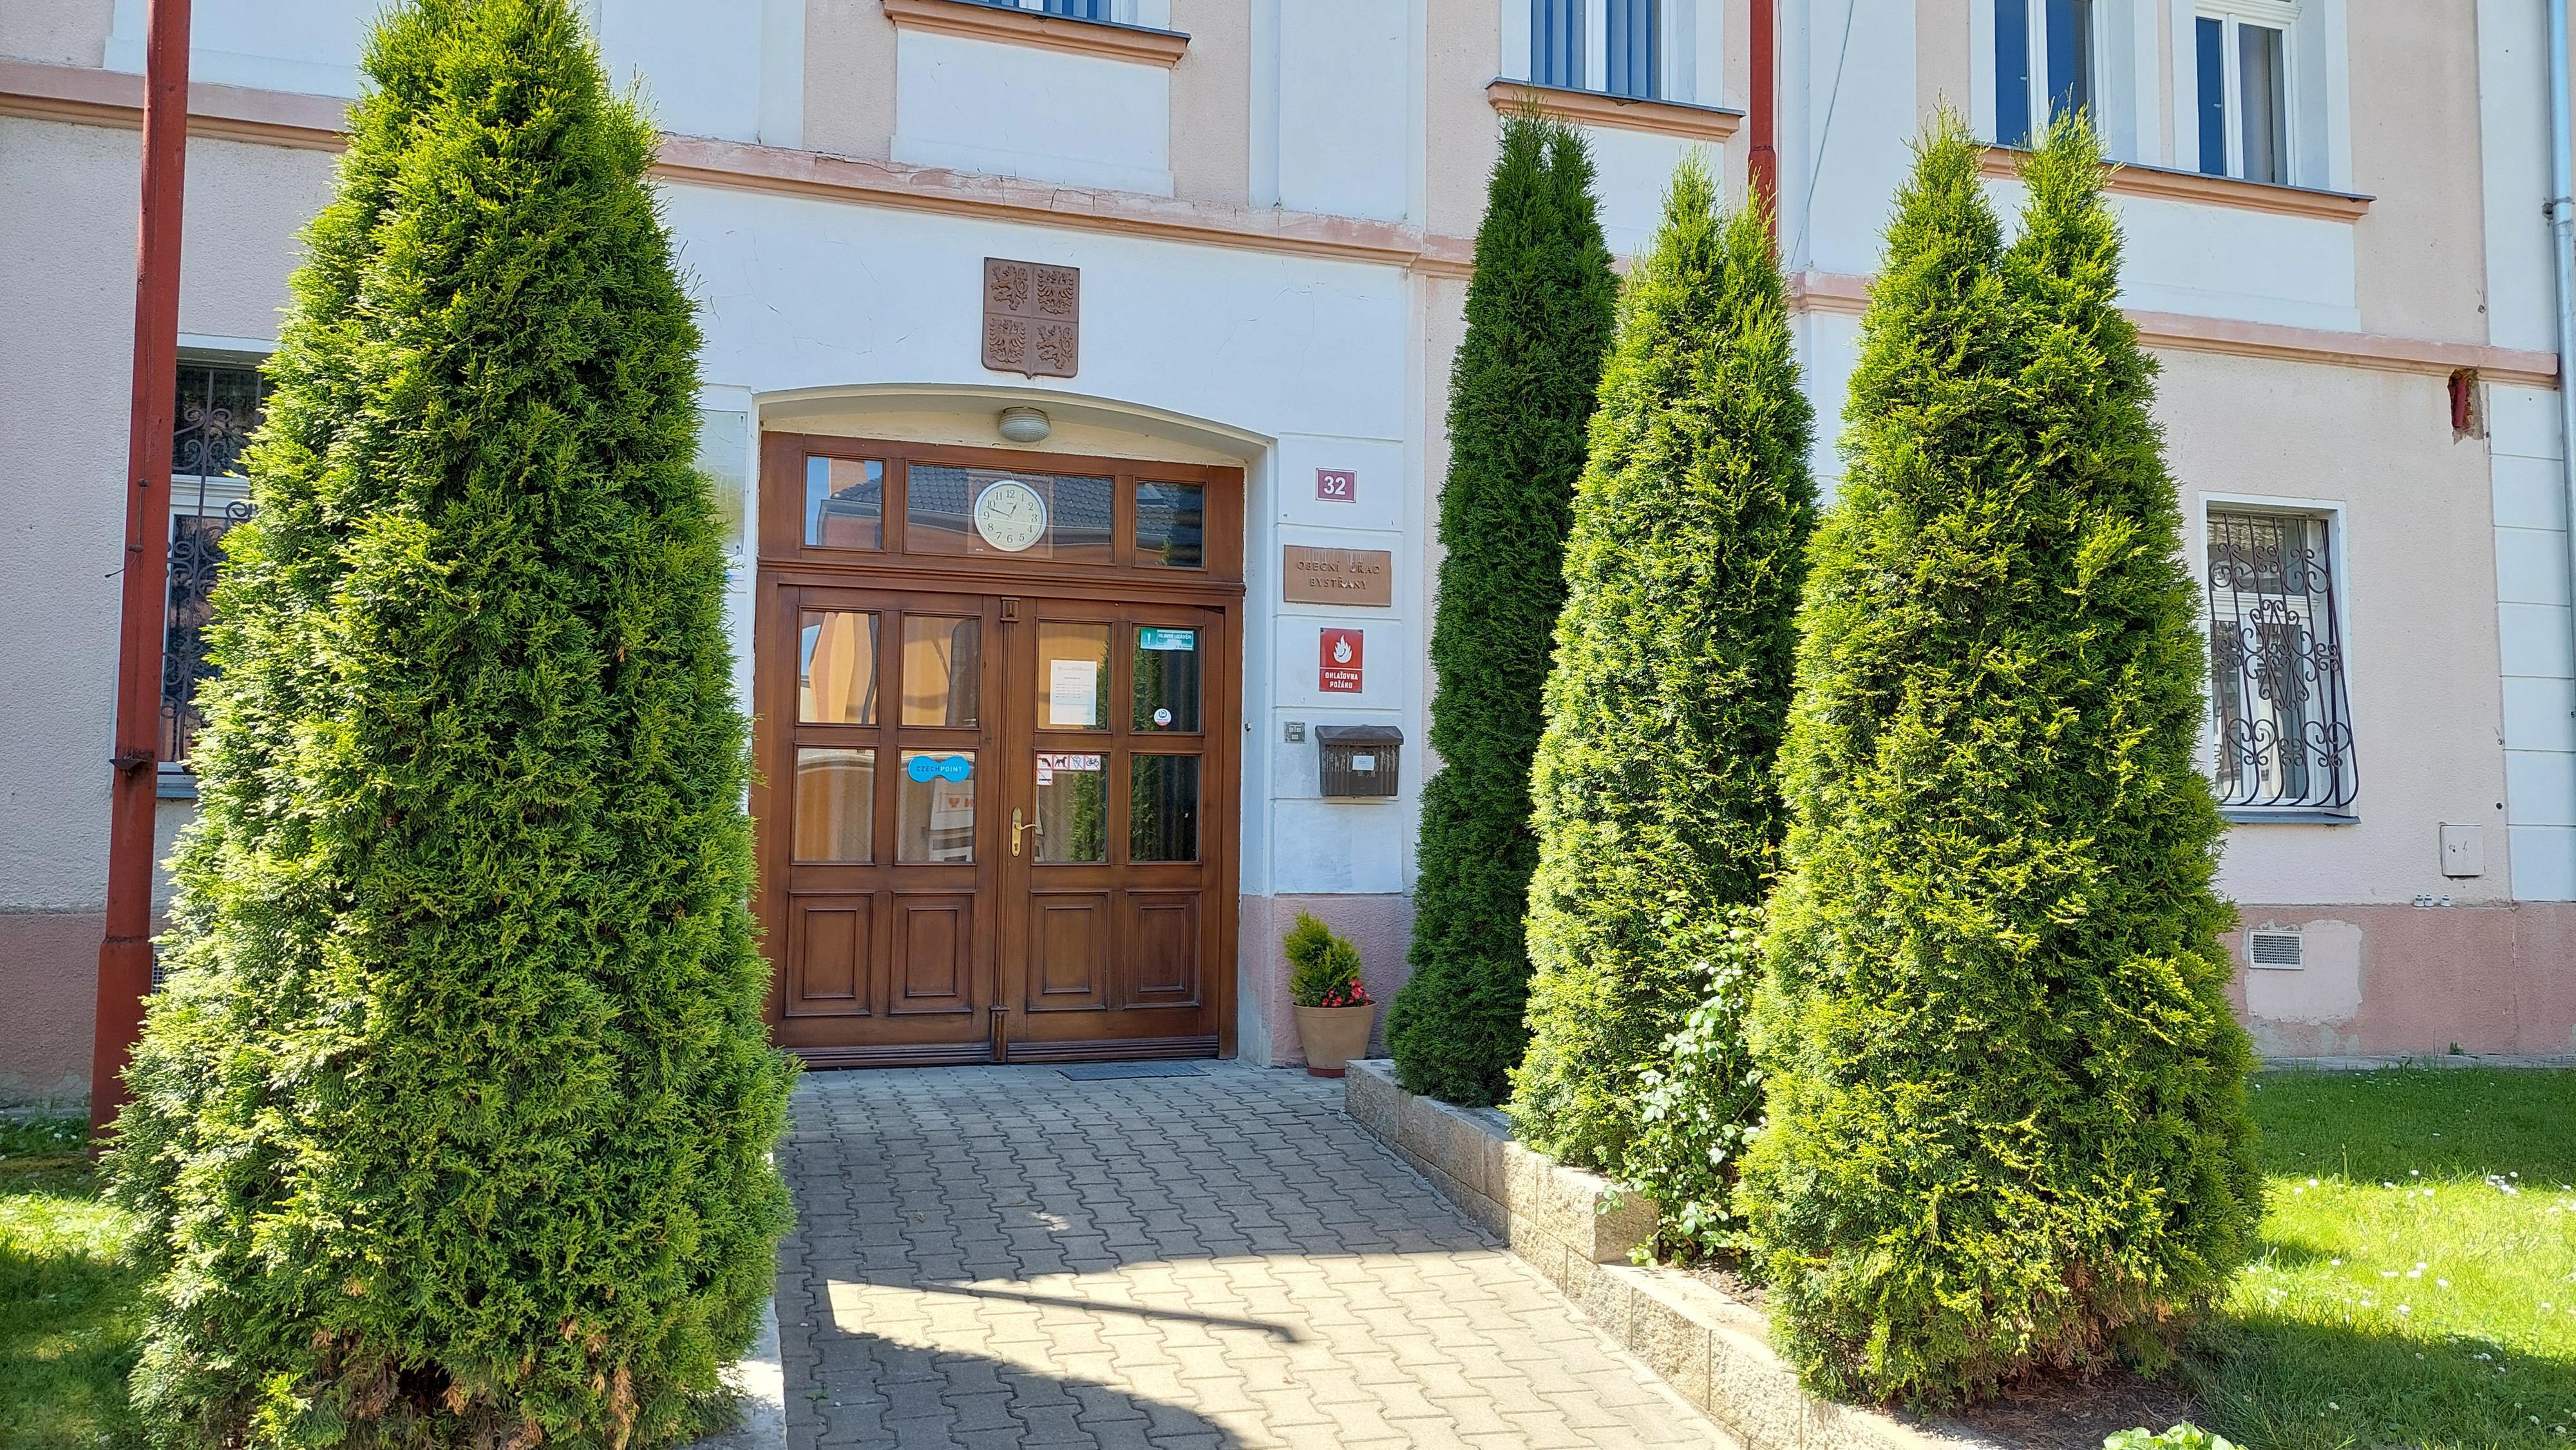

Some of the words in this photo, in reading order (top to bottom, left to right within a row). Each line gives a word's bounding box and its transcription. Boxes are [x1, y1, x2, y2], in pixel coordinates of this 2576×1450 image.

[1323, 476, 1346, 495] 32
[996, 492, 1002, 500] 11
[1007, 489, 1015, 498] 12
[1021, 493, 1024, 502] 1
[987, 499, 996, 508] 10
[1028, 502, 1034, 511] 2
[983, 511, 990, 520] 9
[1031, 514, 1037, 522] 3
[987, 523, 994, 531] 8
[996, 531, 1002, 540] 7
[1007, 534, 1013, 543] 6
[1019, 533, 1025, 541] 5
[1297, 561, 1340, 572] OBECNÍ
[1349, 561, 1381, 574] ÚŘAD
[1310, 575, 1367, 590] BYSTŘANY
[1325, 671, 1358, 681] OHLAŠOVNA
[1329, 680, 1353, 689] POŽÁRU
